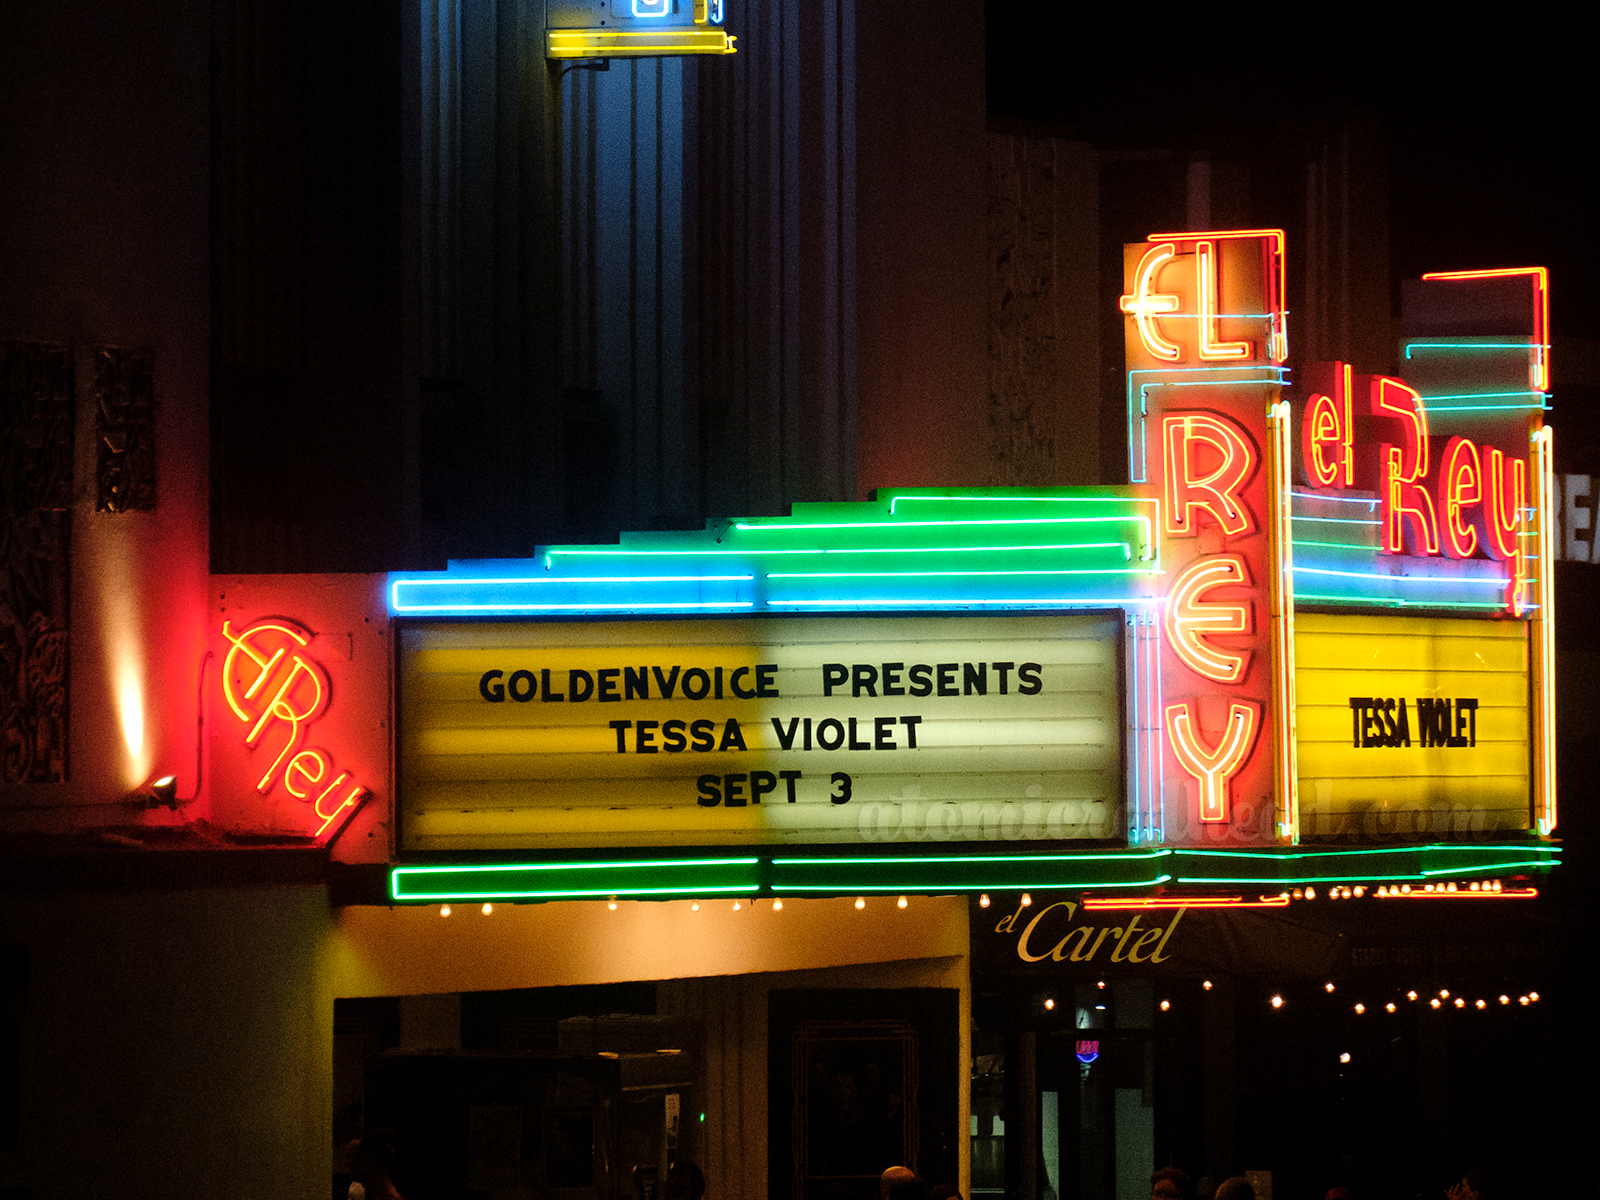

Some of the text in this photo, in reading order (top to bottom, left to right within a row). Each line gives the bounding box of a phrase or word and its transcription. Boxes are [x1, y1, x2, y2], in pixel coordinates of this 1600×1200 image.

[1302, 361, 1354, 489] el
[1371, 375, 1527, 617] Rey
[1120, 242, 1258, 822] EL REY
[478, 661, 1044, 704] GOLDENVOICE PRESENTS
[609, 715, 923, 754] TESSA VIOLET
[1348, 697, 1411, 749] TESSA
[696, 770, 853, 808] SEPT 3
[1016, 901, 1187, 964] Cartel
